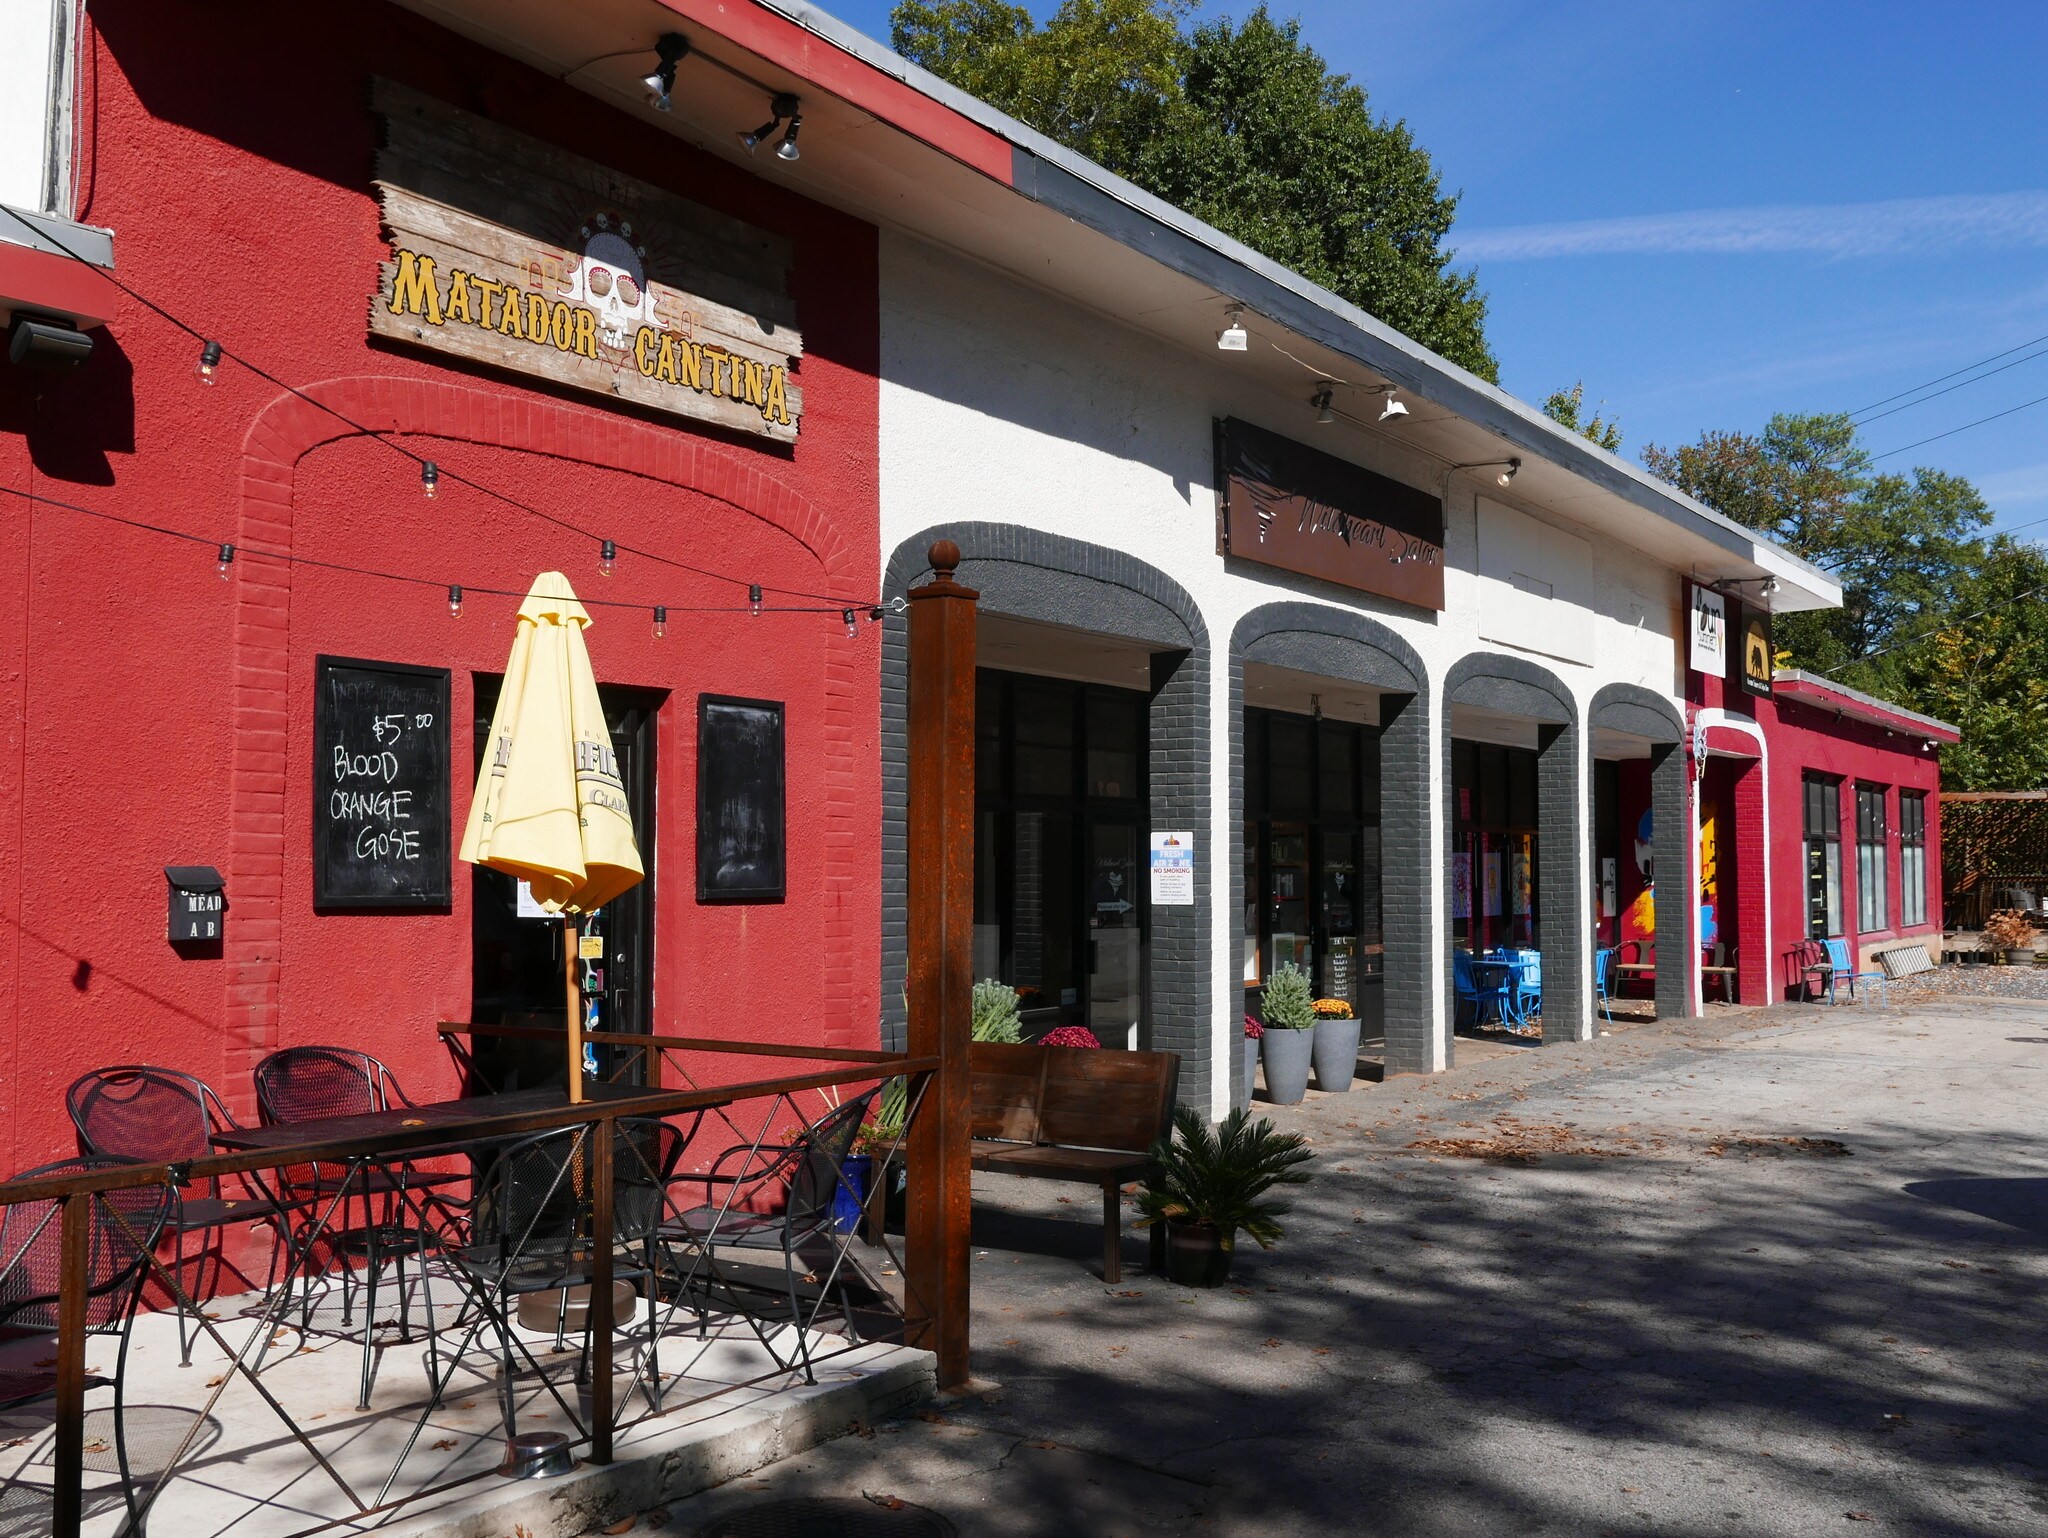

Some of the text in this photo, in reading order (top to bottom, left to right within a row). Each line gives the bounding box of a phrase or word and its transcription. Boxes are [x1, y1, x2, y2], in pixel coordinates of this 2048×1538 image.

[388, 249, 791, 426] MATADOR CANTINA
[372, 713, 433, 745] $5.00
[333, 745, 399, 783] BLOOD
[330, 788, 413, 820] ORANGE
[356, 825, 420, 860] GOSE
[1159, 850, 1184, 858] FRESH
[1153, 859, 1167, 867] AIR
[188, 896, 222, 912] MEAD
[190, 921, 215, 937] A B
